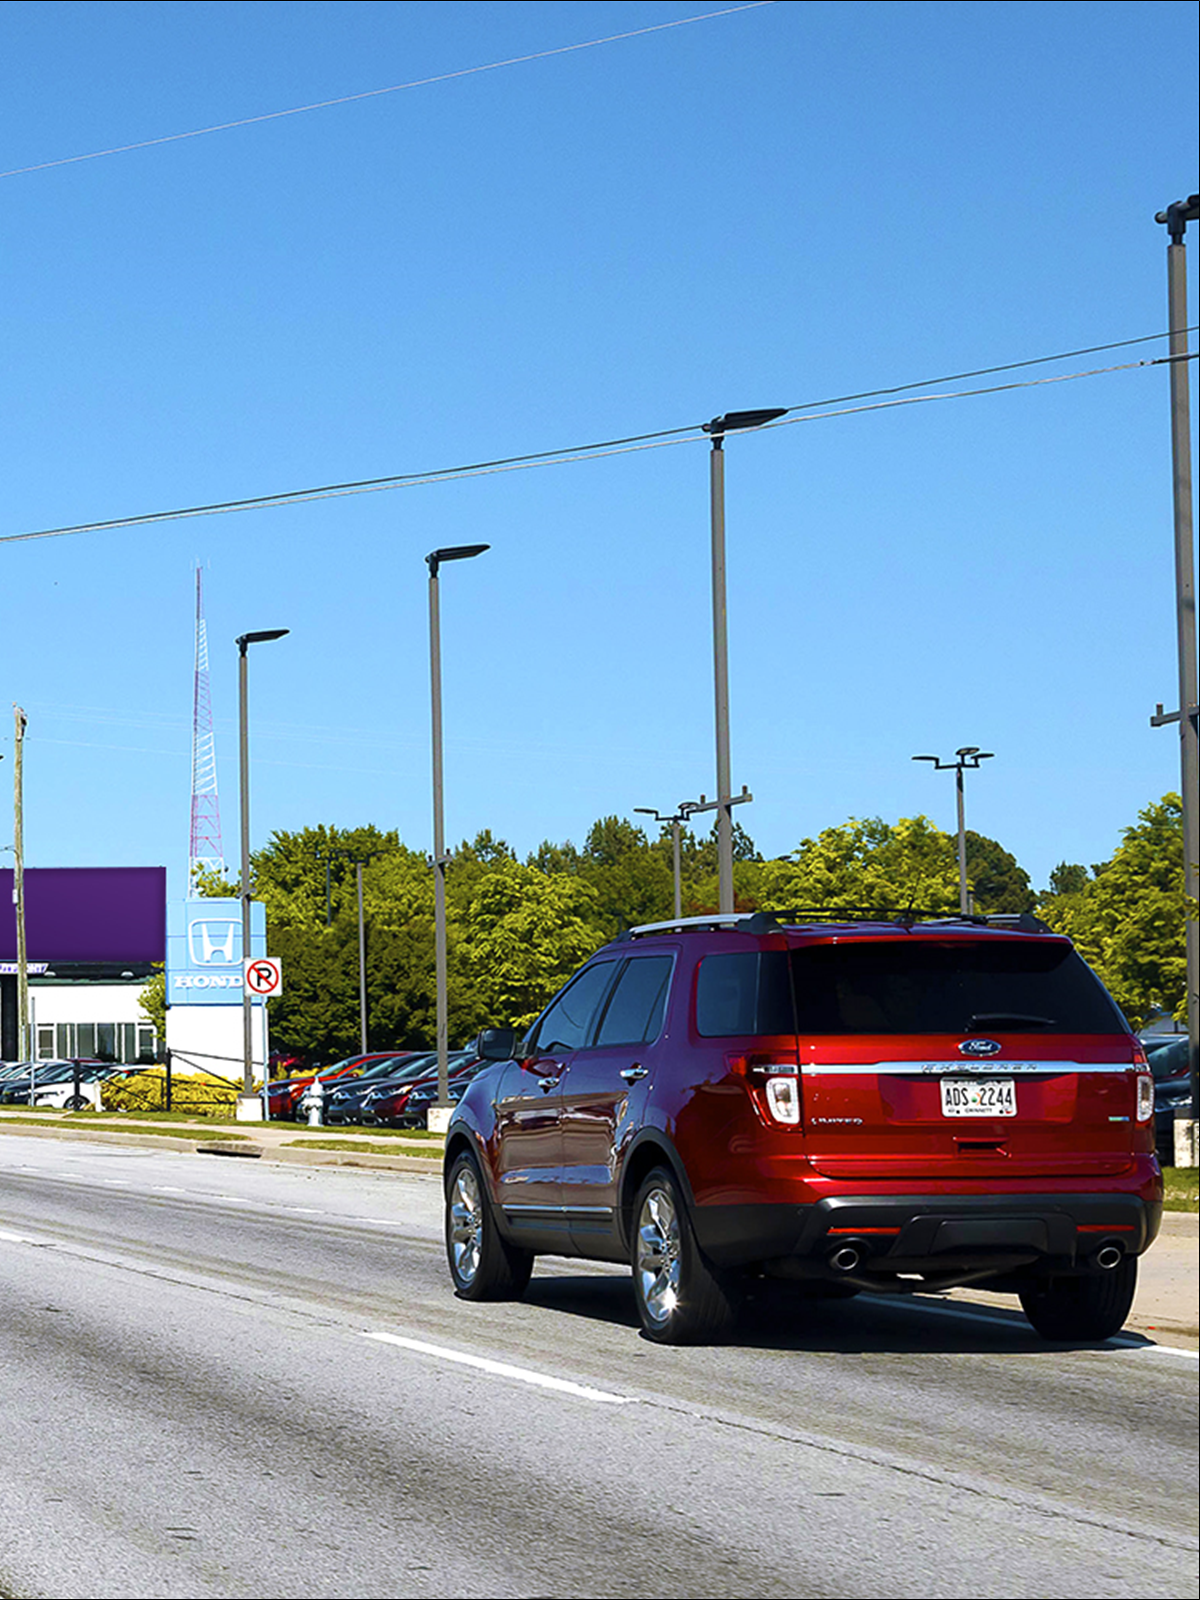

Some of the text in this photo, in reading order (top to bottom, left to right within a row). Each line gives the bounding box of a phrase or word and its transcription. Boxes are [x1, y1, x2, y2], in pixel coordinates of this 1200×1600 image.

[173, 975, 244, 989] HOND
[945, 1087, 1012, 1106] ADS 2244
